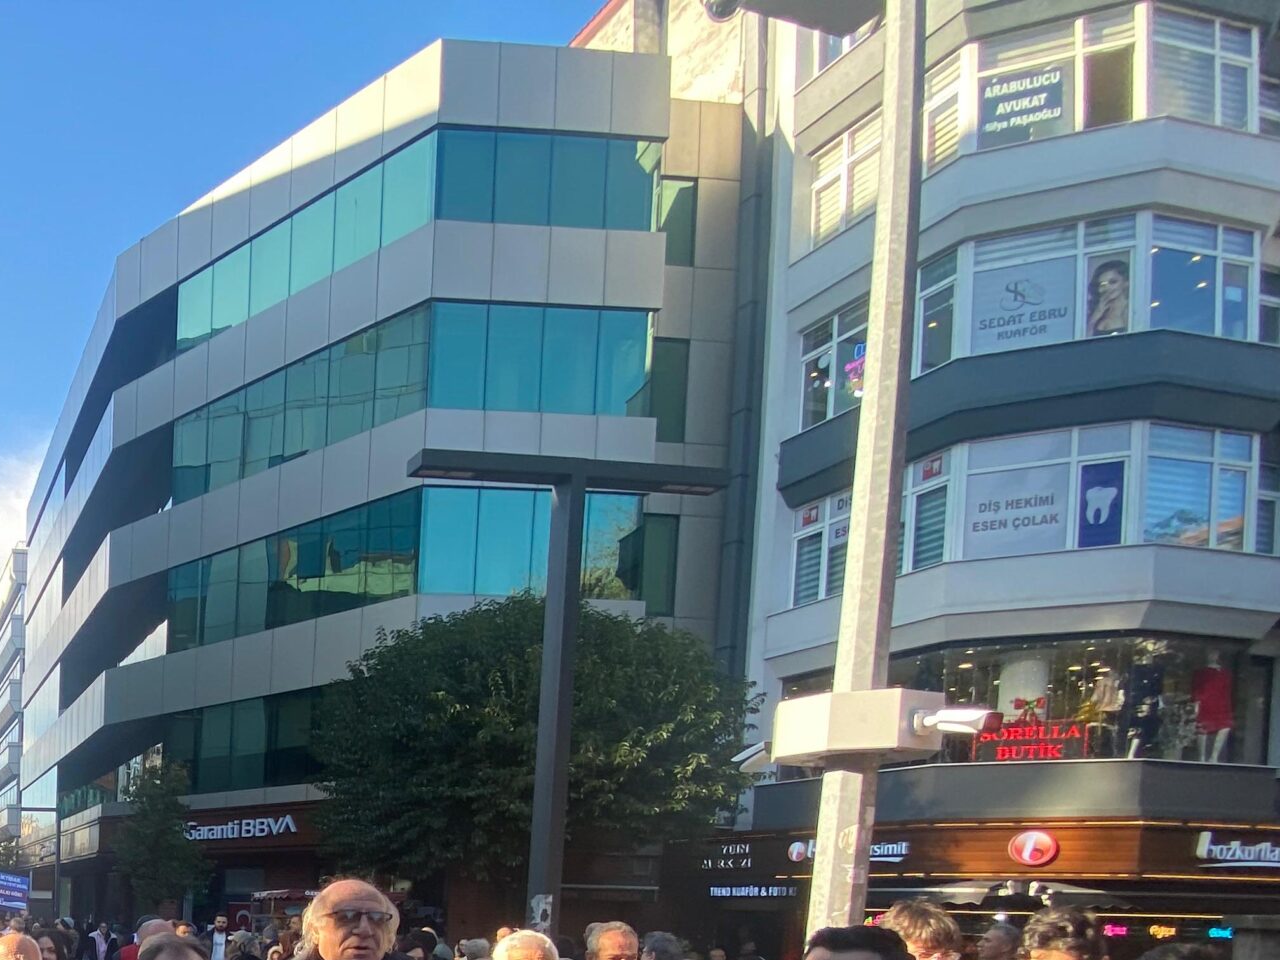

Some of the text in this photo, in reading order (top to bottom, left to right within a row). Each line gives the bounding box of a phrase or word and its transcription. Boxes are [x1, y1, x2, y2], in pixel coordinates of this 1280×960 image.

[984, 71, 1061, 98] ARABULUCU
[996, 93, 1048, 115] AVUKAT
[1009, 107, 1062, 127] PAŞAOĞLU
[978, 307, 1068, 330] SEDAT EBRU
[997, 324, 1048, 340] KUAFÖR
[837, 496, 849, 510] Dİ
[978, 493, 1055, 514] DİŞ HEKİMİ
[972, 513, 1059, 532] ESEN ÇOLAK
[835, 526, 847, 539] ES
[980, 724, 1081, 741] SORELLA
[995, 742, 1064, 760] BUTİK
[183, 814, 297, 840] Garanti BBVA
[710, 886, 731, 897] TREND
[732, 884, 759, 897] KUAFÖR
[760, 886, 768, 897] &
[769, 886, 787, 897] FOTO
